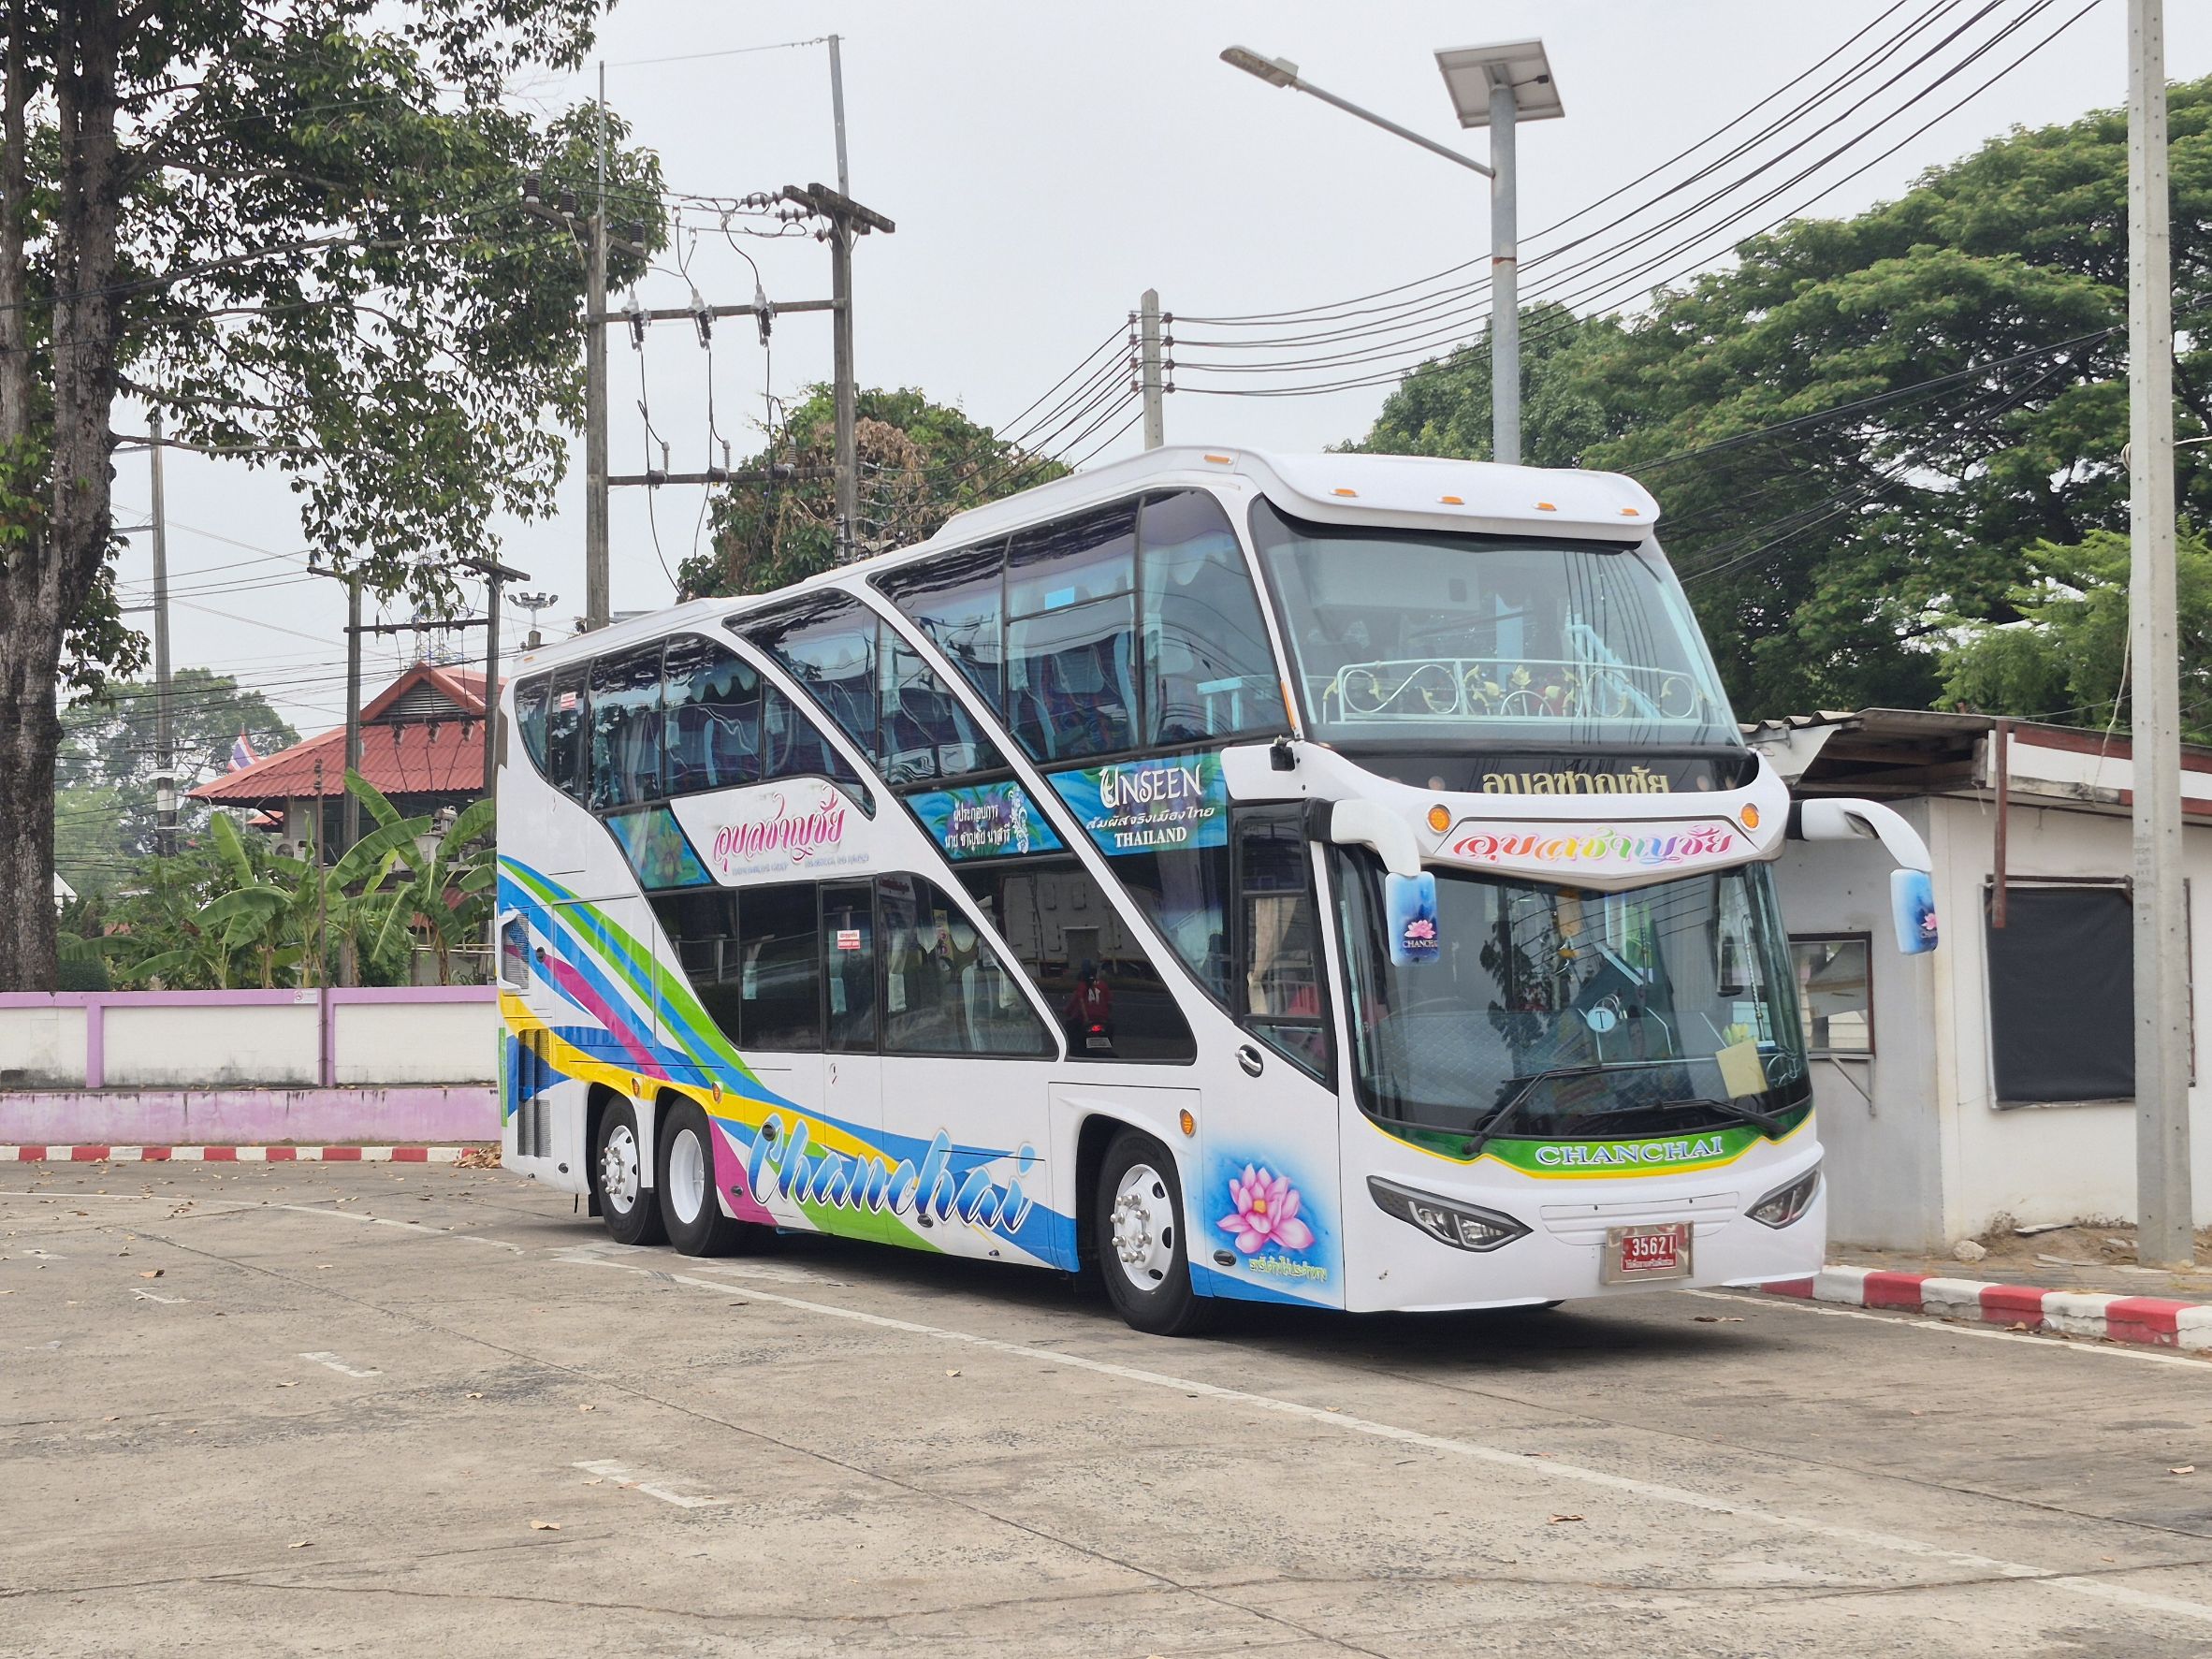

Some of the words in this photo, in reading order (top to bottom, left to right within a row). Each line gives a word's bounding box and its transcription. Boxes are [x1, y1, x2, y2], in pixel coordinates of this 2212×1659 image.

[1099, 764, 1202, 808] UNSEEN
[714, 785, 845, 873] อุบลชาญชัย
[953, 800, 998, 830] ผู้ประกอบการ
[1114, 826, 1187, 848] THAILAND
[1451, 824, 1734, 865] อุบลชาญชัย
[1535, 1136, 1724, 1165] CHANCHAI
[747, 1113, 1035, 1234] Chanchai
[1632, 1235, 1673, 1257] 35621
